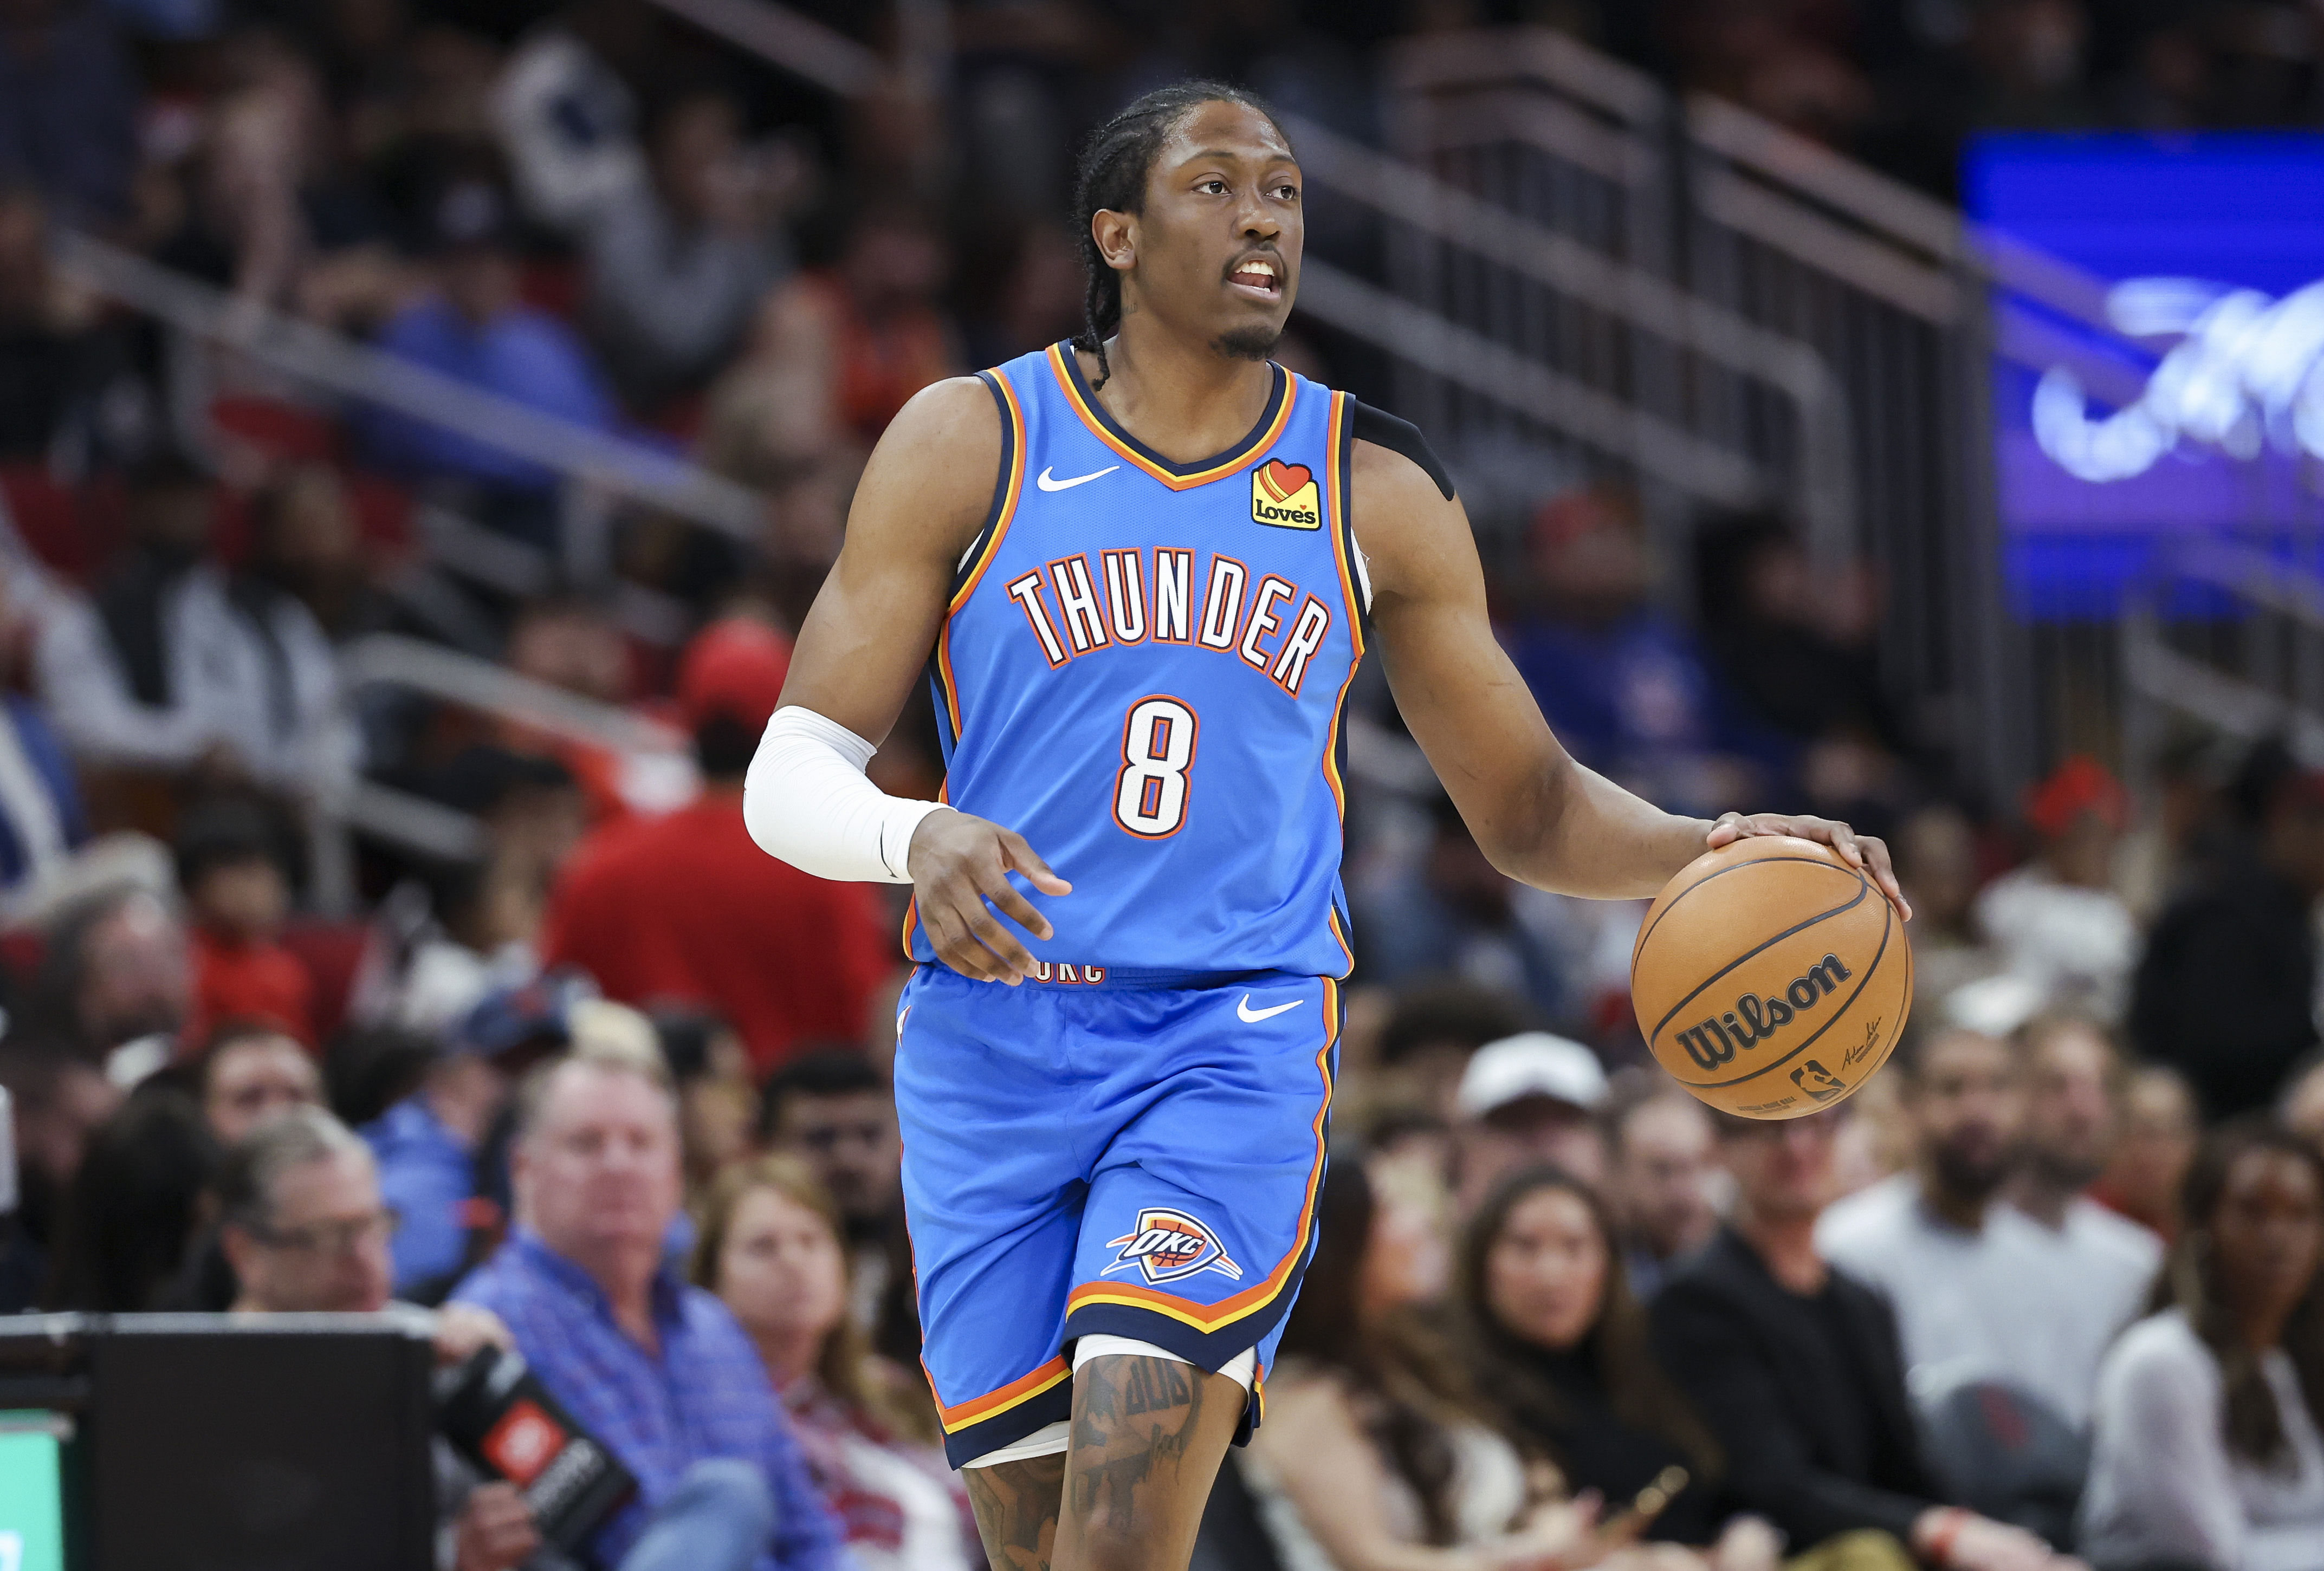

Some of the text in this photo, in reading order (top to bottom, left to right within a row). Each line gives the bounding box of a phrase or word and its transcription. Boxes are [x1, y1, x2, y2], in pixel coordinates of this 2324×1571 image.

[1004, 546, 1331, 700] THUNDER
[1111, 693, 1200, 840] 8
[1674, 953, 1852, 1070] Wilson
[1122, 1228, 1206, 1258] OKC
